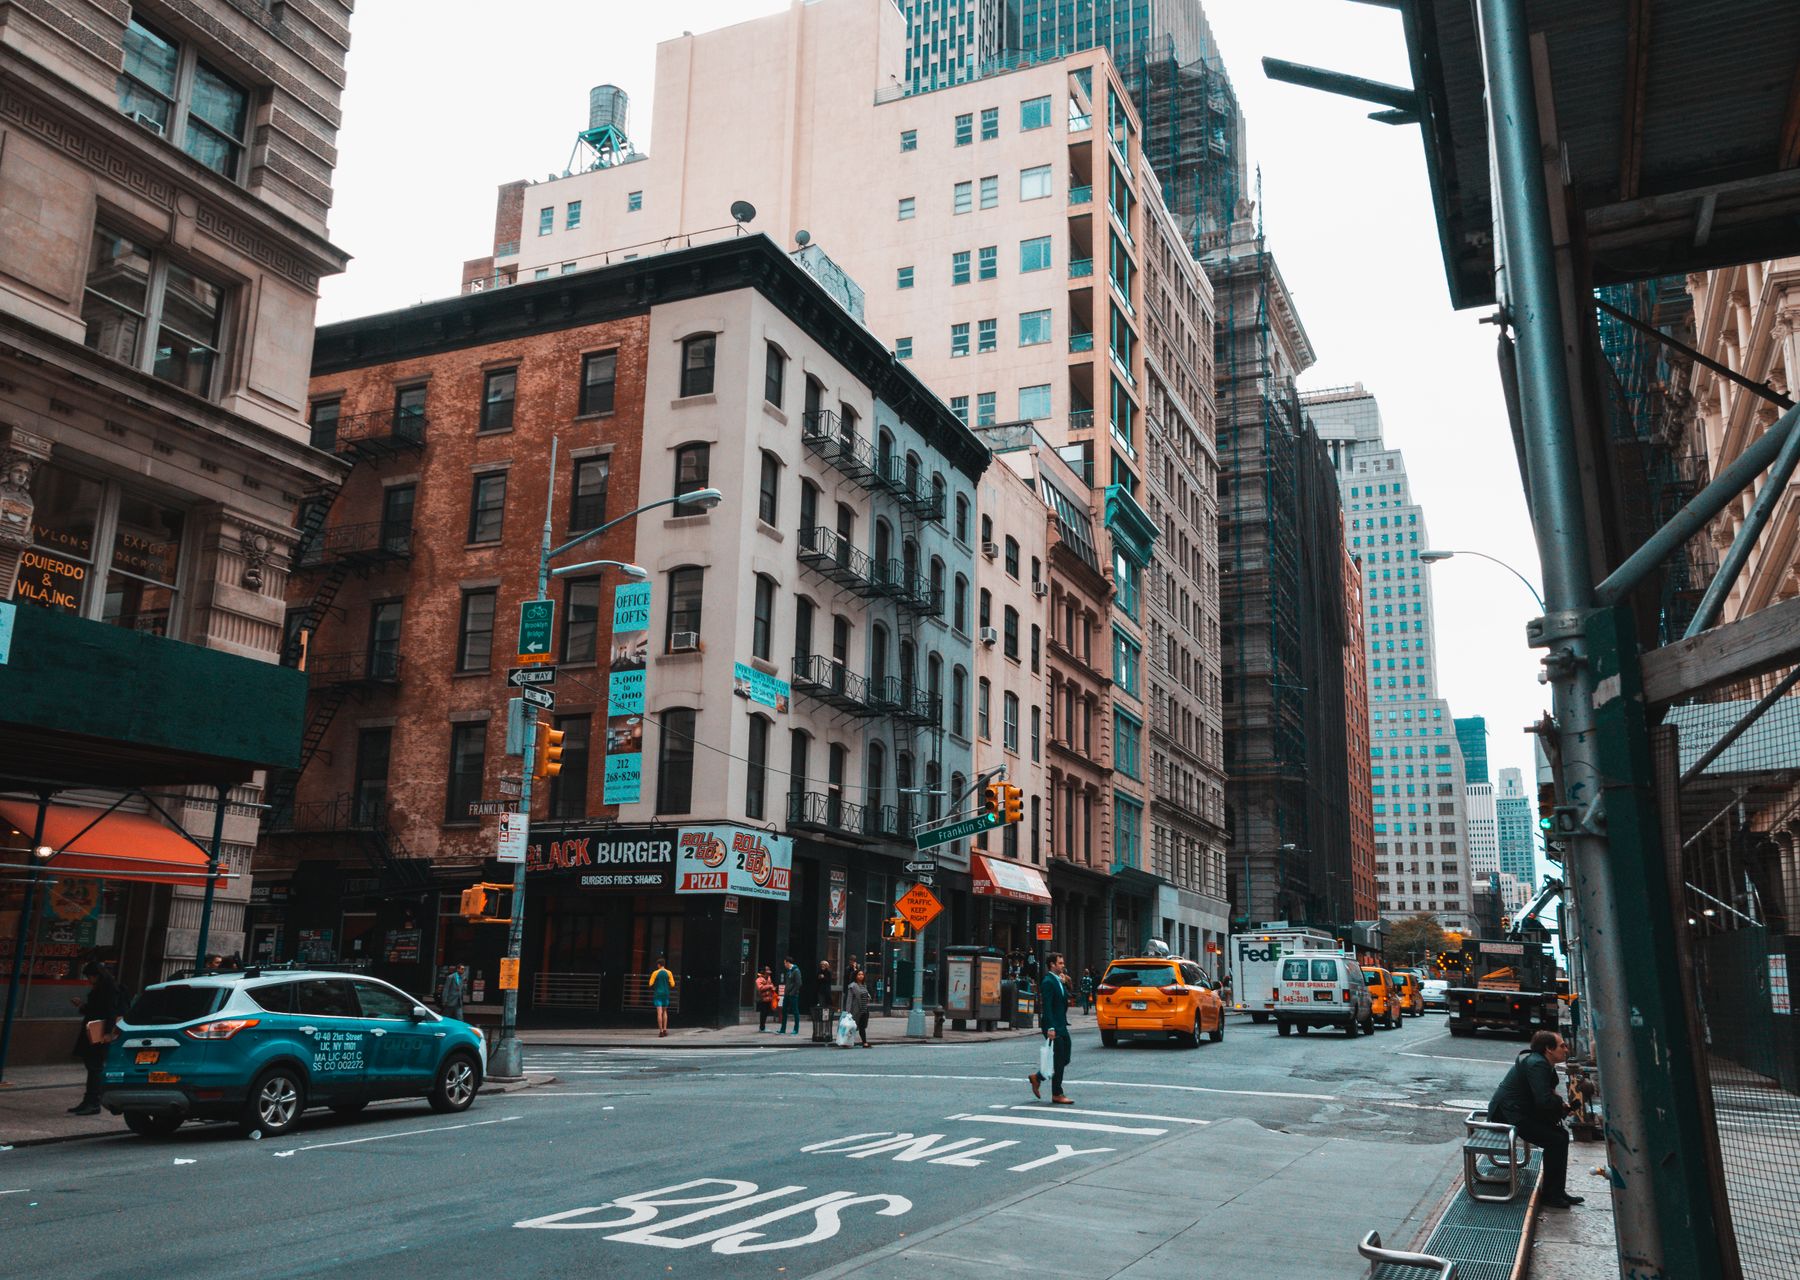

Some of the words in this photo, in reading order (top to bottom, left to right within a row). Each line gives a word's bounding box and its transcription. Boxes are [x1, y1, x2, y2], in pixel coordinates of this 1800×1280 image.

[20, 551, 84, 580] ZQUIERDO
[42, 573, 52, 587] &
[616, 592, 650, 609] OFFICE
[615, 609, 648, 625] LOFTS
[524, 622, 549, 630] Brooklyn
[516, 673, 533, 682] ONE
[534, 672, 550, 681] WAY
[527, 689, 537, 699] ONE
[540, 693, 551, 703] WAY
[616, 758, 629, 769] 212
[605, 770, 640, 783] 268-8290
[468, 803, 505, 816] FRANKLIN
[508, 802, 518, 813] ST
[938, 822, 975, 841] Franklin
[977, 817, 986, 828] St
[680, 832, 717, 848] ROLL
[732, 831, 762, 853] ROLL
[597, 840, 673, 864] BURGER
[684, 847, 695, 859] 2
[736, 853, 746, 870] 2
[581, 875, 613, 886] BURGERS
[614, 875, 633, 885] FRIES
[634, 874, 662, 885] SHAKES
[691, 873, 722, 889] PIZZA
[772, 869, 789, 889] PIZZA
[911, 890, 929, 898] THRU
[907, 898, 932, 906] TRAFFIC
[332, 1032, 344, 1041] 21st
[345, 1032, 363, 1041] Street
[333, 1042, 342, 1051] NY
[314, 1053, 326, 1062] MA
[328, 1052, 340, 1061] LIC
[342, 1051, 355, 1061] 401
[356, 1051, 362, 1060] C
[312, 1062, 322, 1072] SS
[324, 1061, 336, 1071] CO
[337, 1060, 364, 1070] 002272
[801, 1131, 1116, 1172] ONLY
[512, 1178, 913, 1254] BUS
